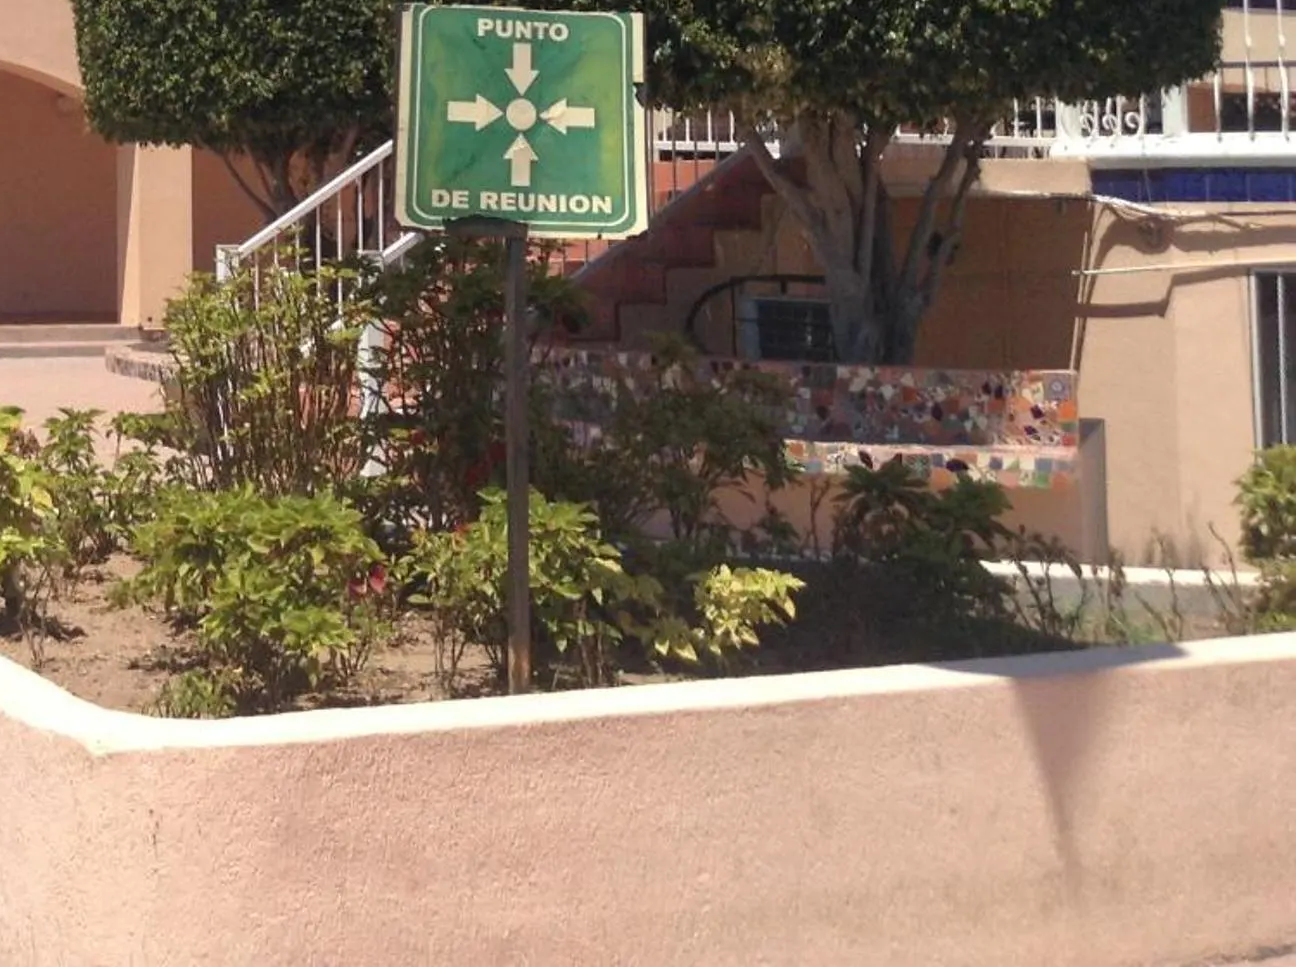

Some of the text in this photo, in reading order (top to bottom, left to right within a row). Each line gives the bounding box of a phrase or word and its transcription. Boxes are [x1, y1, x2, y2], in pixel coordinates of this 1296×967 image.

[477, 17, 569, 42] PUNTO
[431, 189, 612, 214] DE REUNION
